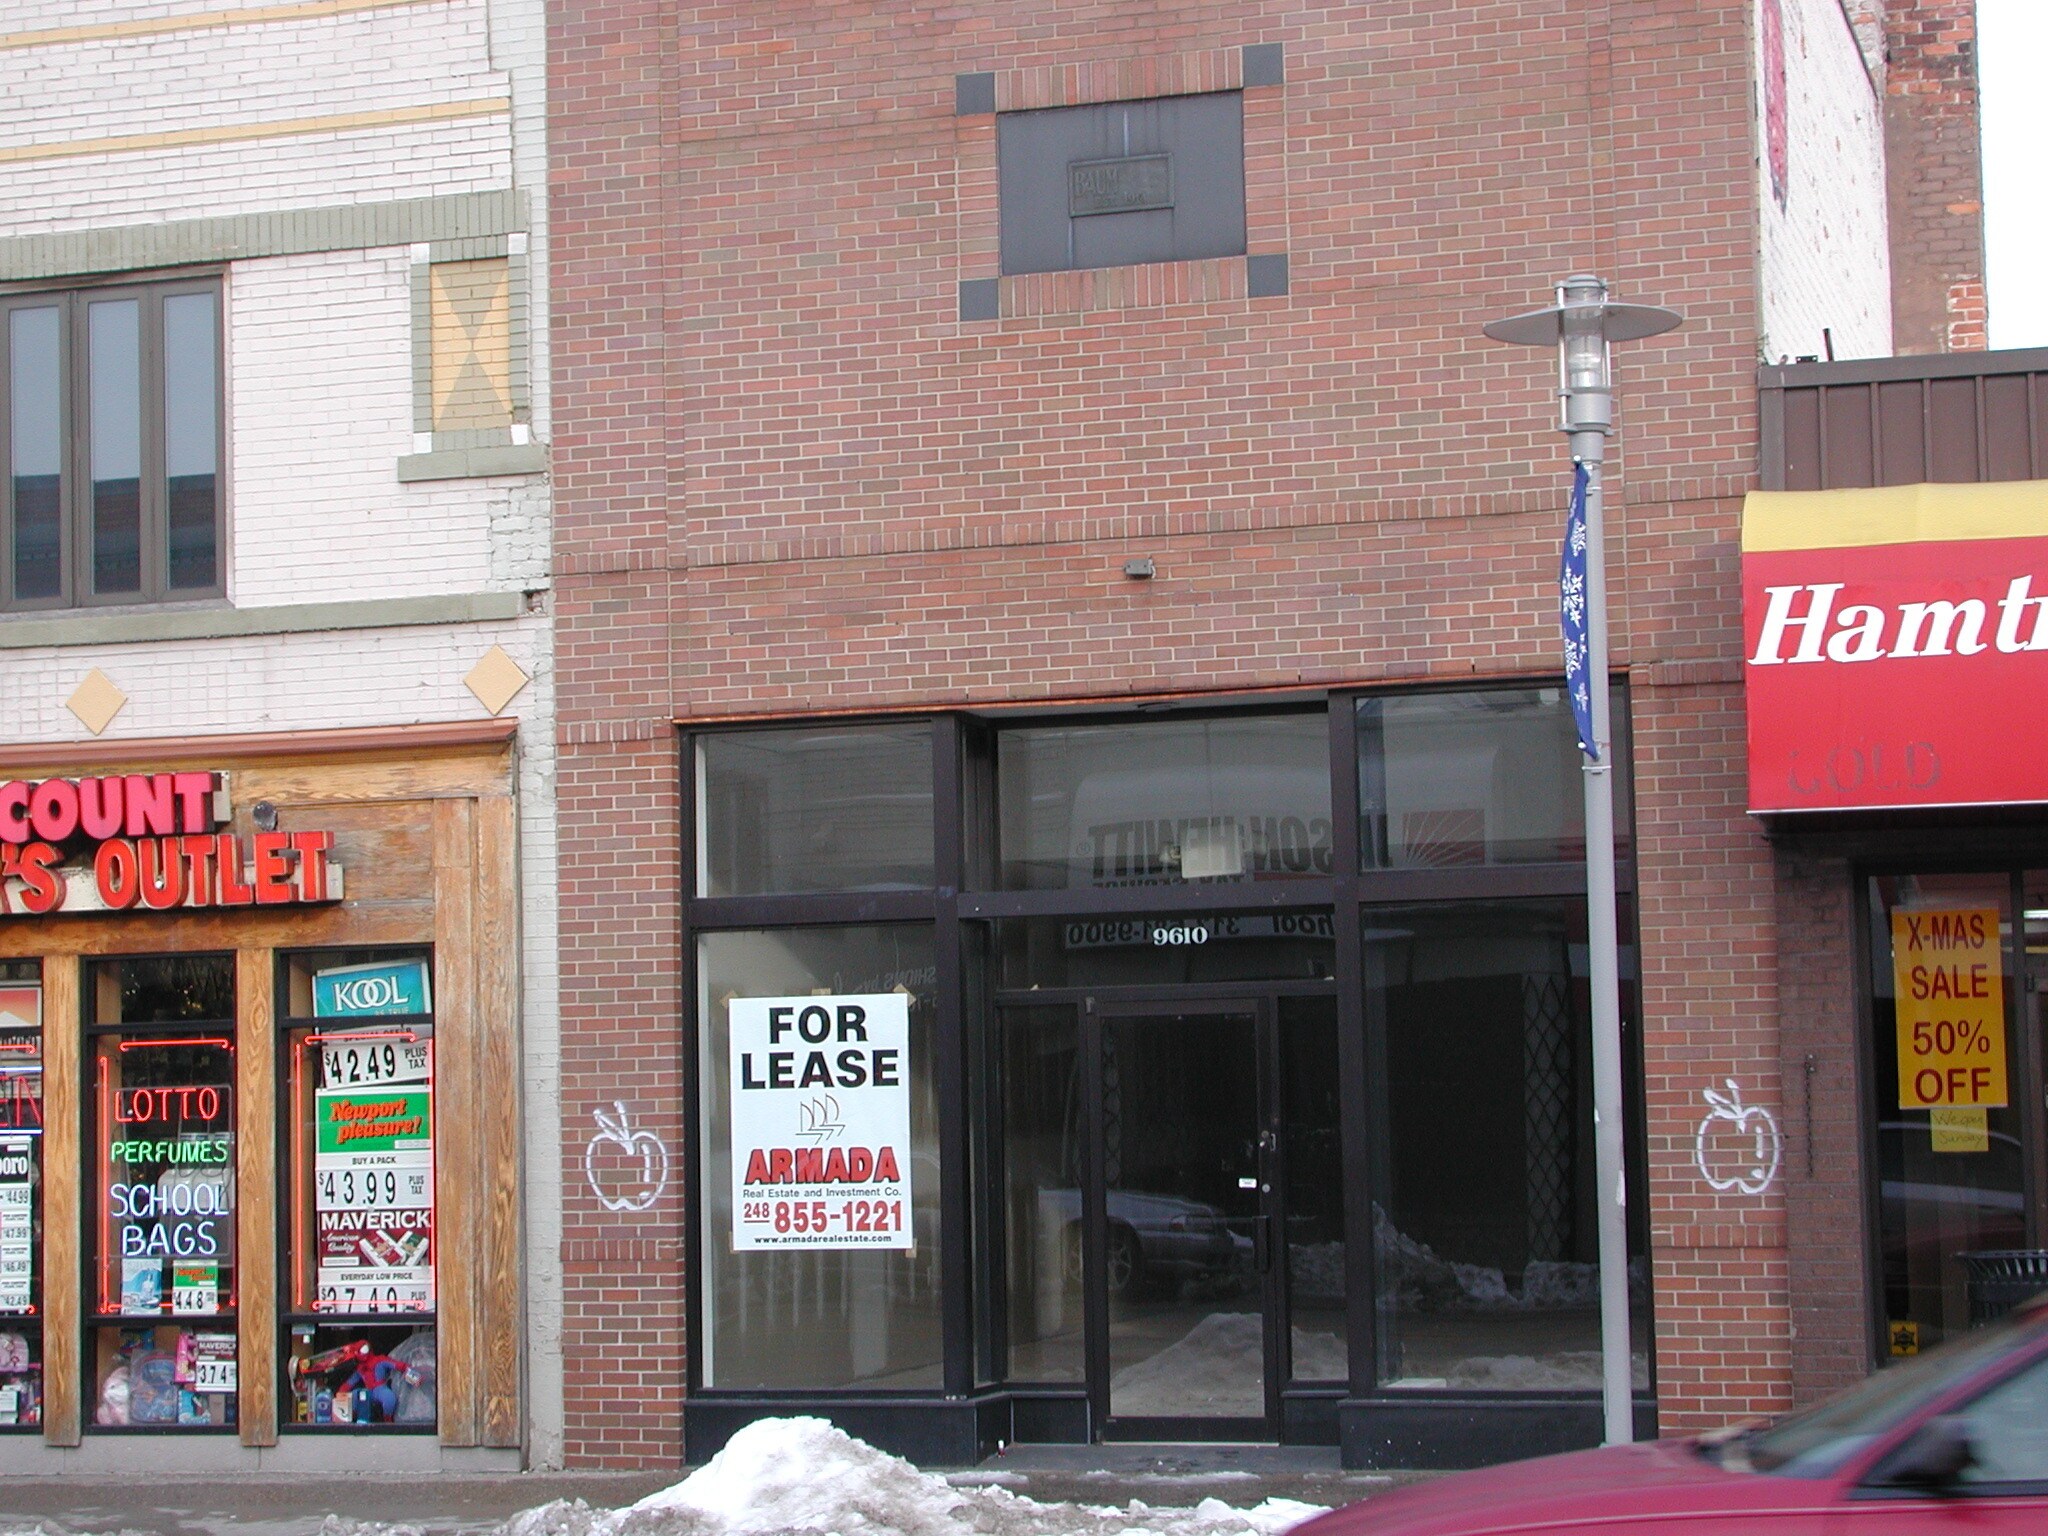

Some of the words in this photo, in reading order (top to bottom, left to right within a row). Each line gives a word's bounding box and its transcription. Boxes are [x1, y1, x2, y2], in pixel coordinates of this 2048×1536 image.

[0, 842, 66, 913] 'S
[94, 831, 334, 910] OUTLET
[1153, 927, 1208, 945] 9610
[1907, 914, 1985, 951] X-MAS
[334, 975, 410, 1011] KOOL
[1911, 964, 1988, 1000] SALE
[769, 1005, 868, 1044] FOR
[1913, 1019, 1990, 1056] 50%
[325, 1044, 395, 1083] $42.49
[404, 1047, 427, 1058] PLUS
[408, 1059, 426, 1069] TAX
[742, 1049, 899, 1090] LEASE
[1915, 1067, 1991, 1104] OFF
[114, 1087, 220, 1122] LOTTO
[329, 1098, 407, 1123] Newport
[337, 1116, 422, 1145] pleasure!
[0, 1156, 28, 1175] oro
[111, 1141, 229, 1164] PERFUMES
[352, 1157, 368, 1165] BUY
[377, 1156, 396, 1164] PACK
[744, 1146, 900, 1185] ARMADA
[110, 1183, 229, 1217] SCHOOL
[319, 1171, 396, 1204] $43.99
[409, 1175, 424, 1185] PLUS
[411, 1186, 422, 1194] TAX
[743, 1189, 764, 1198] Real
[769, 1189, 800, 1197] Estate
[804, 1187, 822, 1197] and
[827, 1187, 880, 1197] Investment
[885, 1187, 902, 1196] Co.
[321, 1210, 431, 1230] MAVERICK
[744, 1202, 770, 1218] 248
[775, 1200, 902, 1233] 855-1221
[122, 1221, 217, 1256] BAGS
[754, 1235, 892, 1243] www.armadarealestate.com
[341, 1273, 374, 1281] EVERYDAY
[392, 1272, 412, 1280] PRICE
